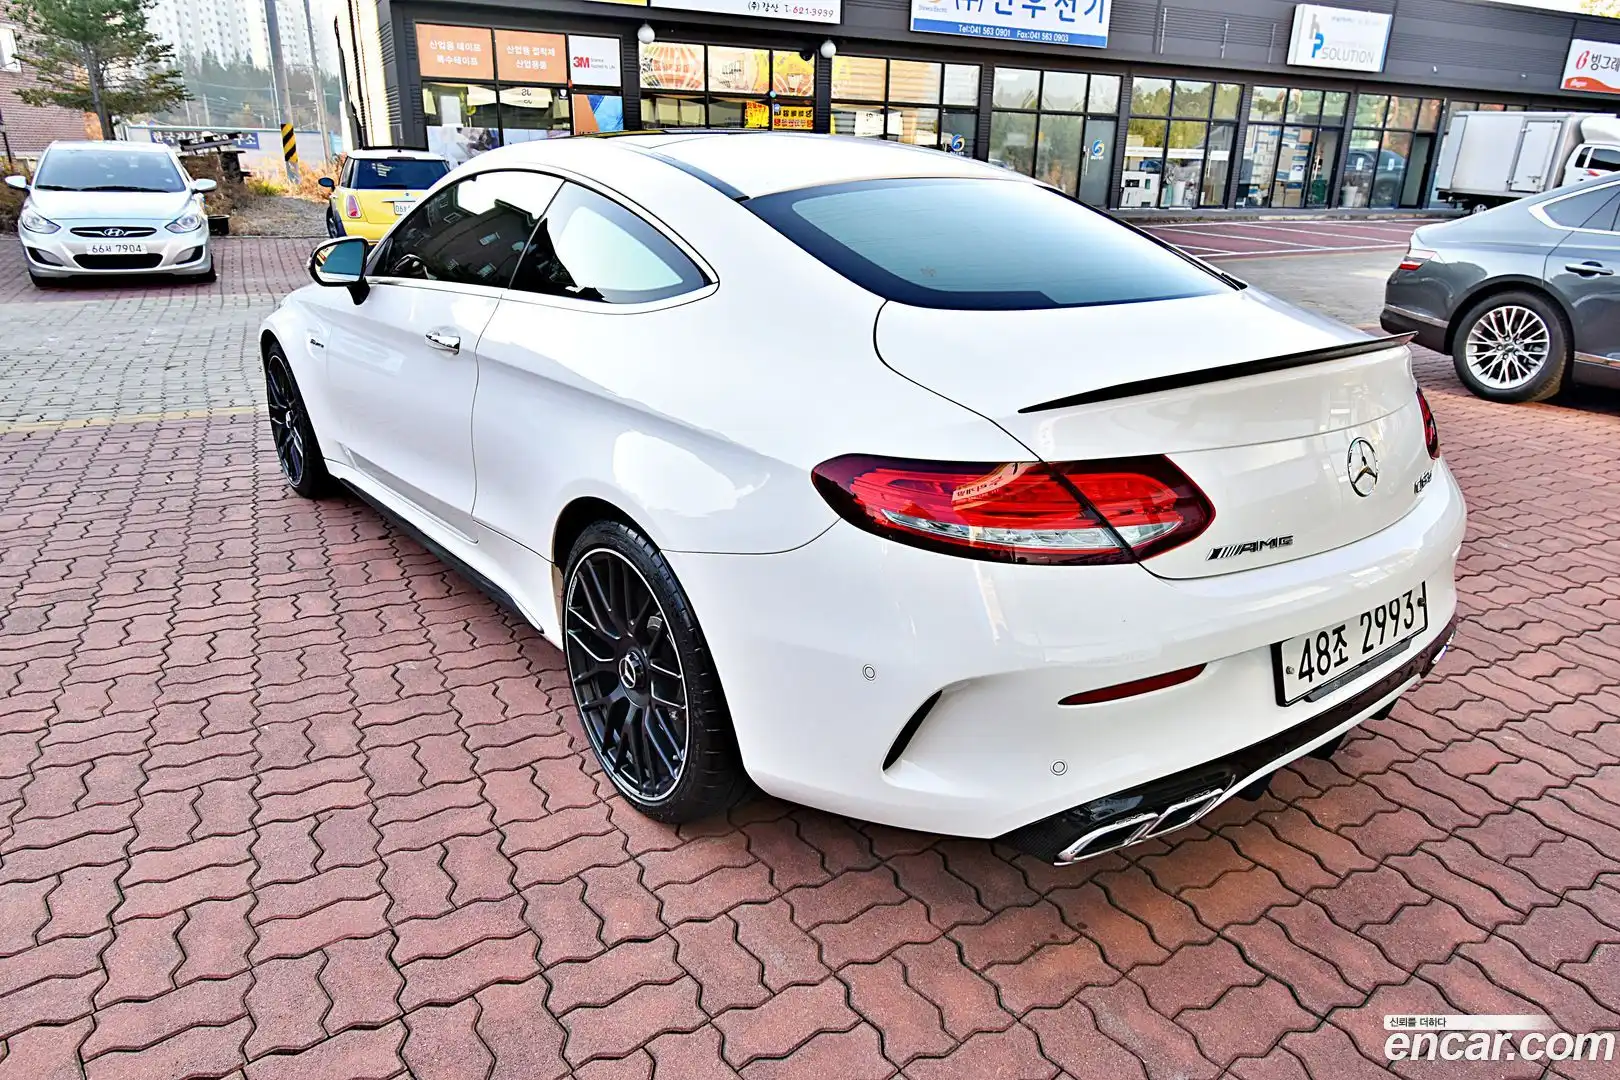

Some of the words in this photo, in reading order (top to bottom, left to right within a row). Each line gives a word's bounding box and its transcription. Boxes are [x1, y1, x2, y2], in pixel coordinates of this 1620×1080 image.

[573, 56, 590, 69] 3M
[1320, 47, 1374, 64] SOLUTION
[115, 244, 142, 253] 7904
[1297, 624, 1349, 683] 48조
[1359, 589, 1415, 655] 2993
